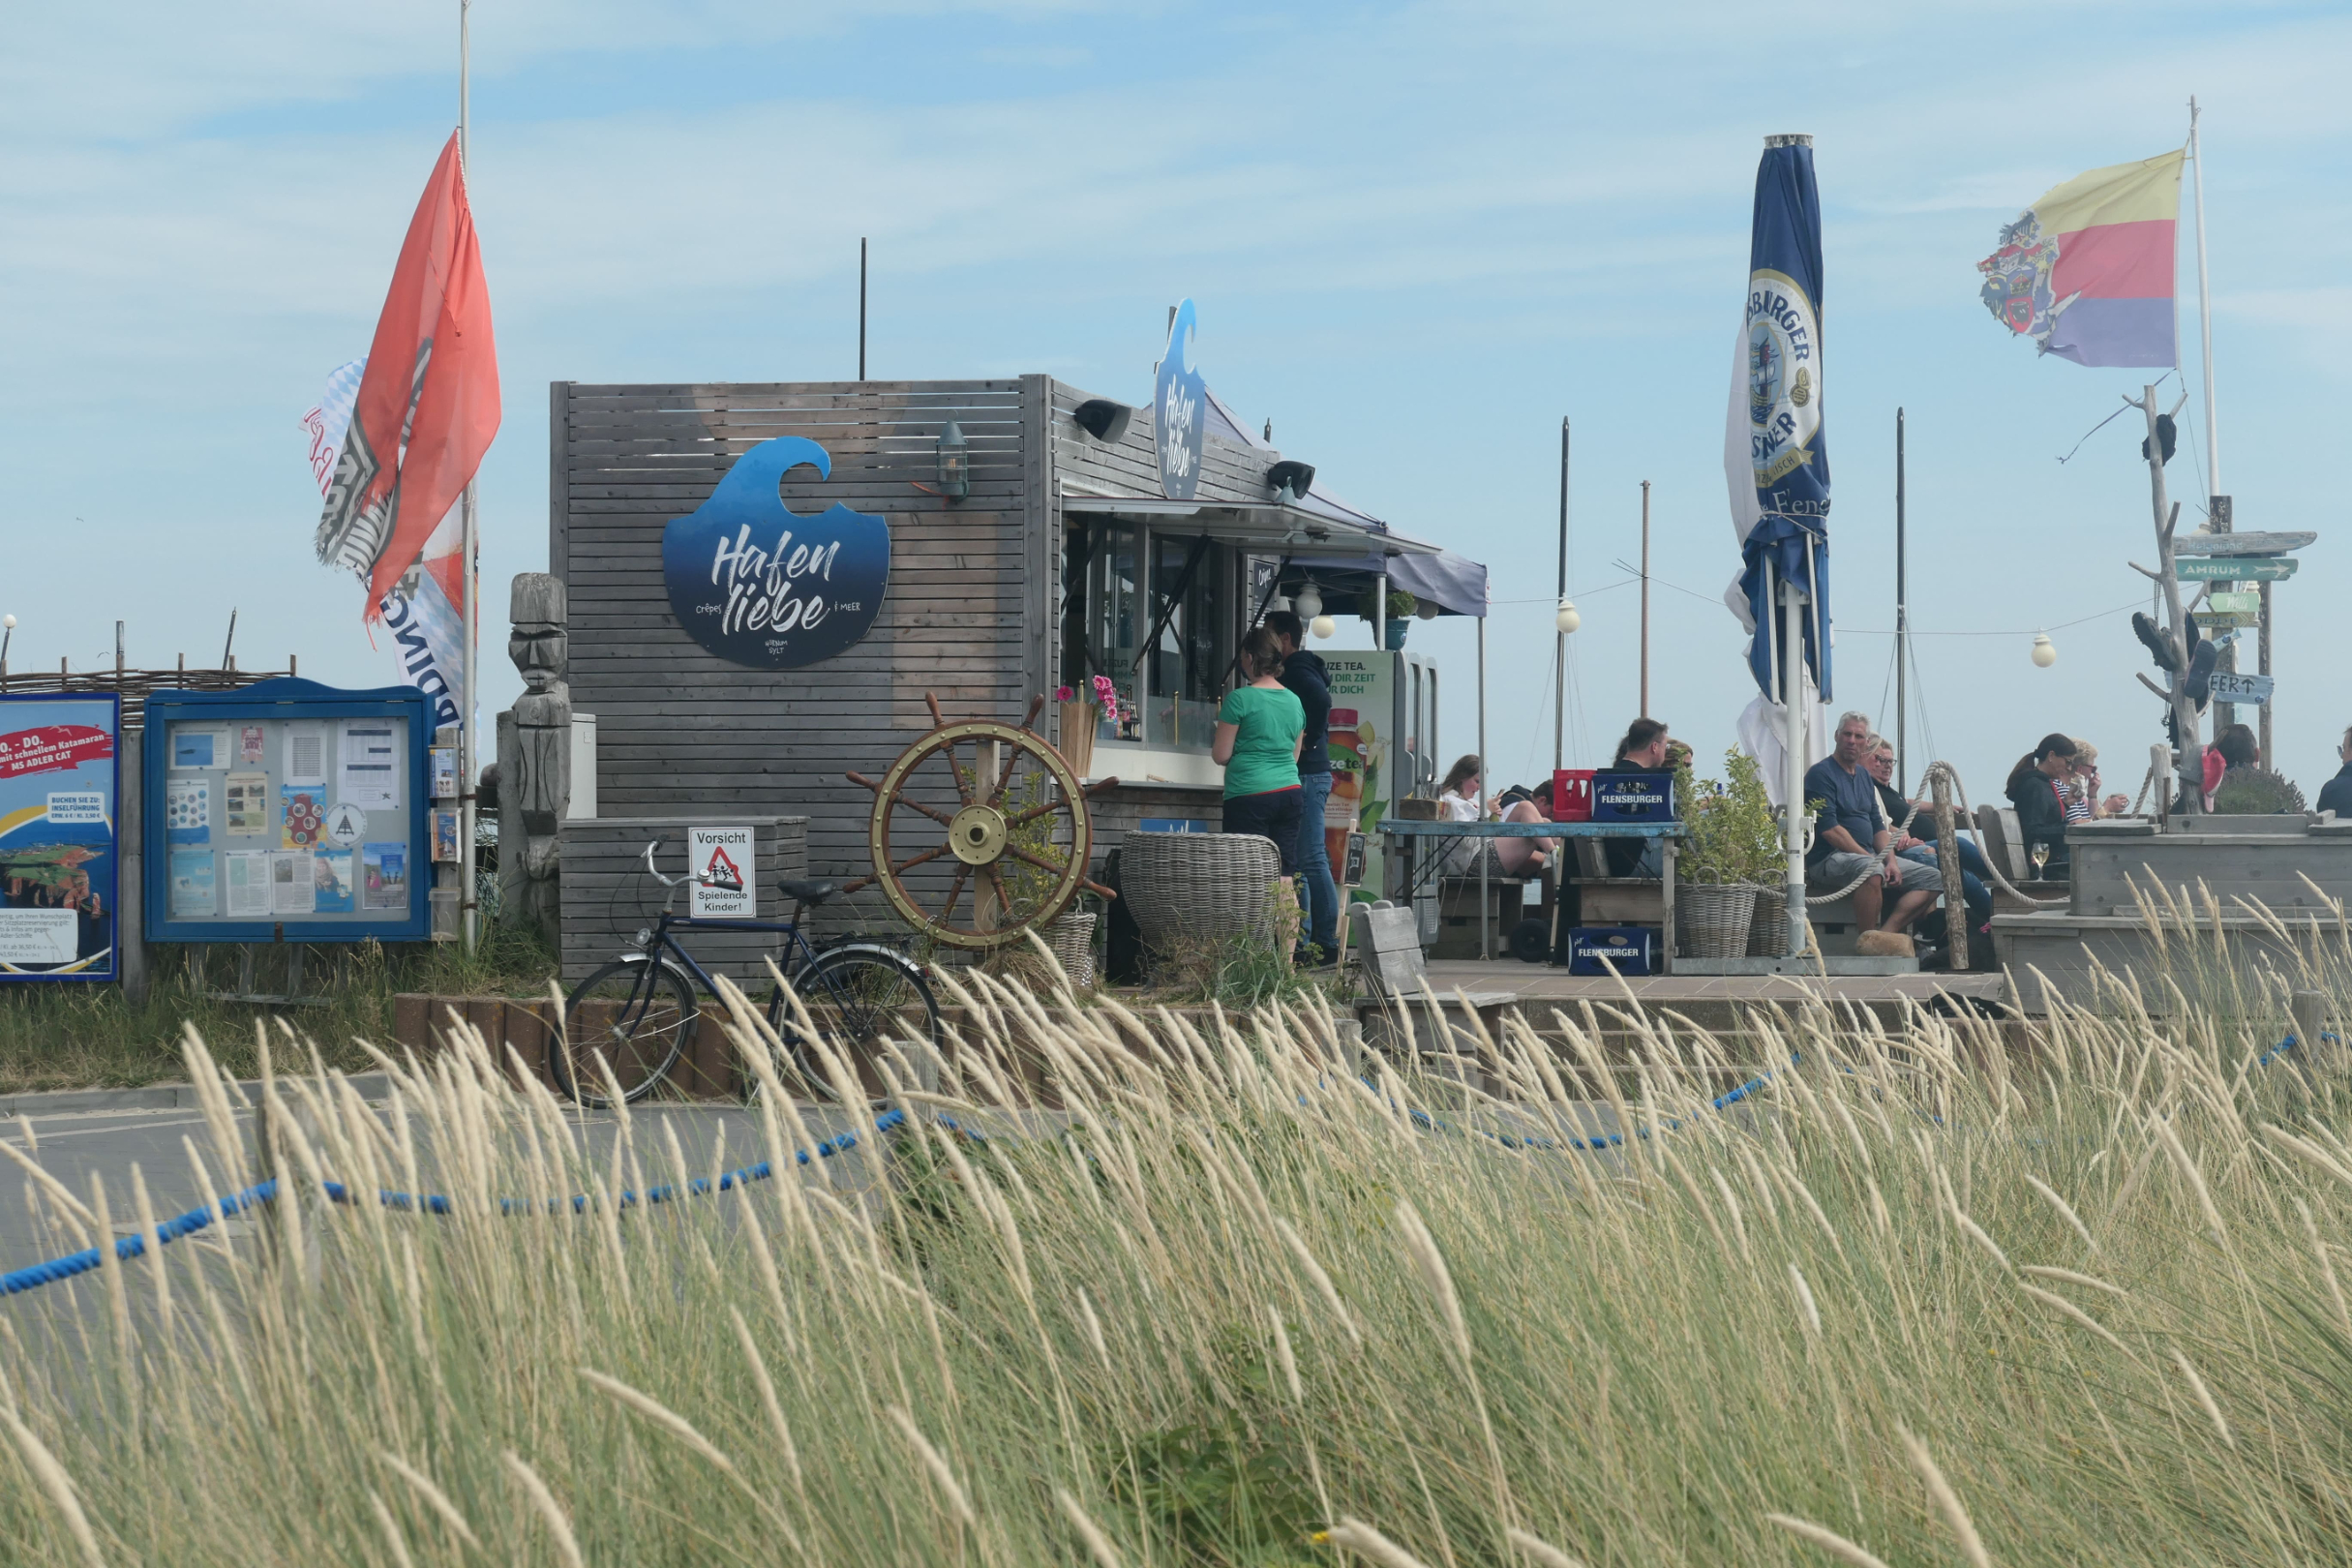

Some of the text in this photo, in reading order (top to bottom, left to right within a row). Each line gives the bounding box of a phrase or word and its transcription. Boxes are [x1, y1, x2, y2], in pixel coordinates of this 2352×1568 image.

[1165, 374, 1195, 442] Hafen
[1751, 412, 1796, 460] SNER
[1167, 429, 1190, 476] liebe
[1773, 455, 1795, 475] ISCH
[711, 524, 840, 596] Hafen
[2185, 565, 2241, 575] AMRUM
[722, 581, 830, 636] liebe
[840, 602, 860, 612] MEER
[769, 647, 784, 655] SYLT
[1336, 674, 1352, 682] DIR
[1354, 674, 1375, 682] ZEIT
[1341, 685, 1364, 694] DICH
[2210, 676, 2239, 693] EER
[15, 744, 56, 760] schnellem
[58, 734, 105, 750] Katamaran
[23, 736, 44, 748] DO.
[12, 750, 72, 770] MS ADLER CAT
[1602, 795, 1663, 803] FLENSBURGER
[697, 832, 745, 844] Vorsicht
[698, 891, 747, 901] Spielende
[705, 903, 741, 912] Kinder!
